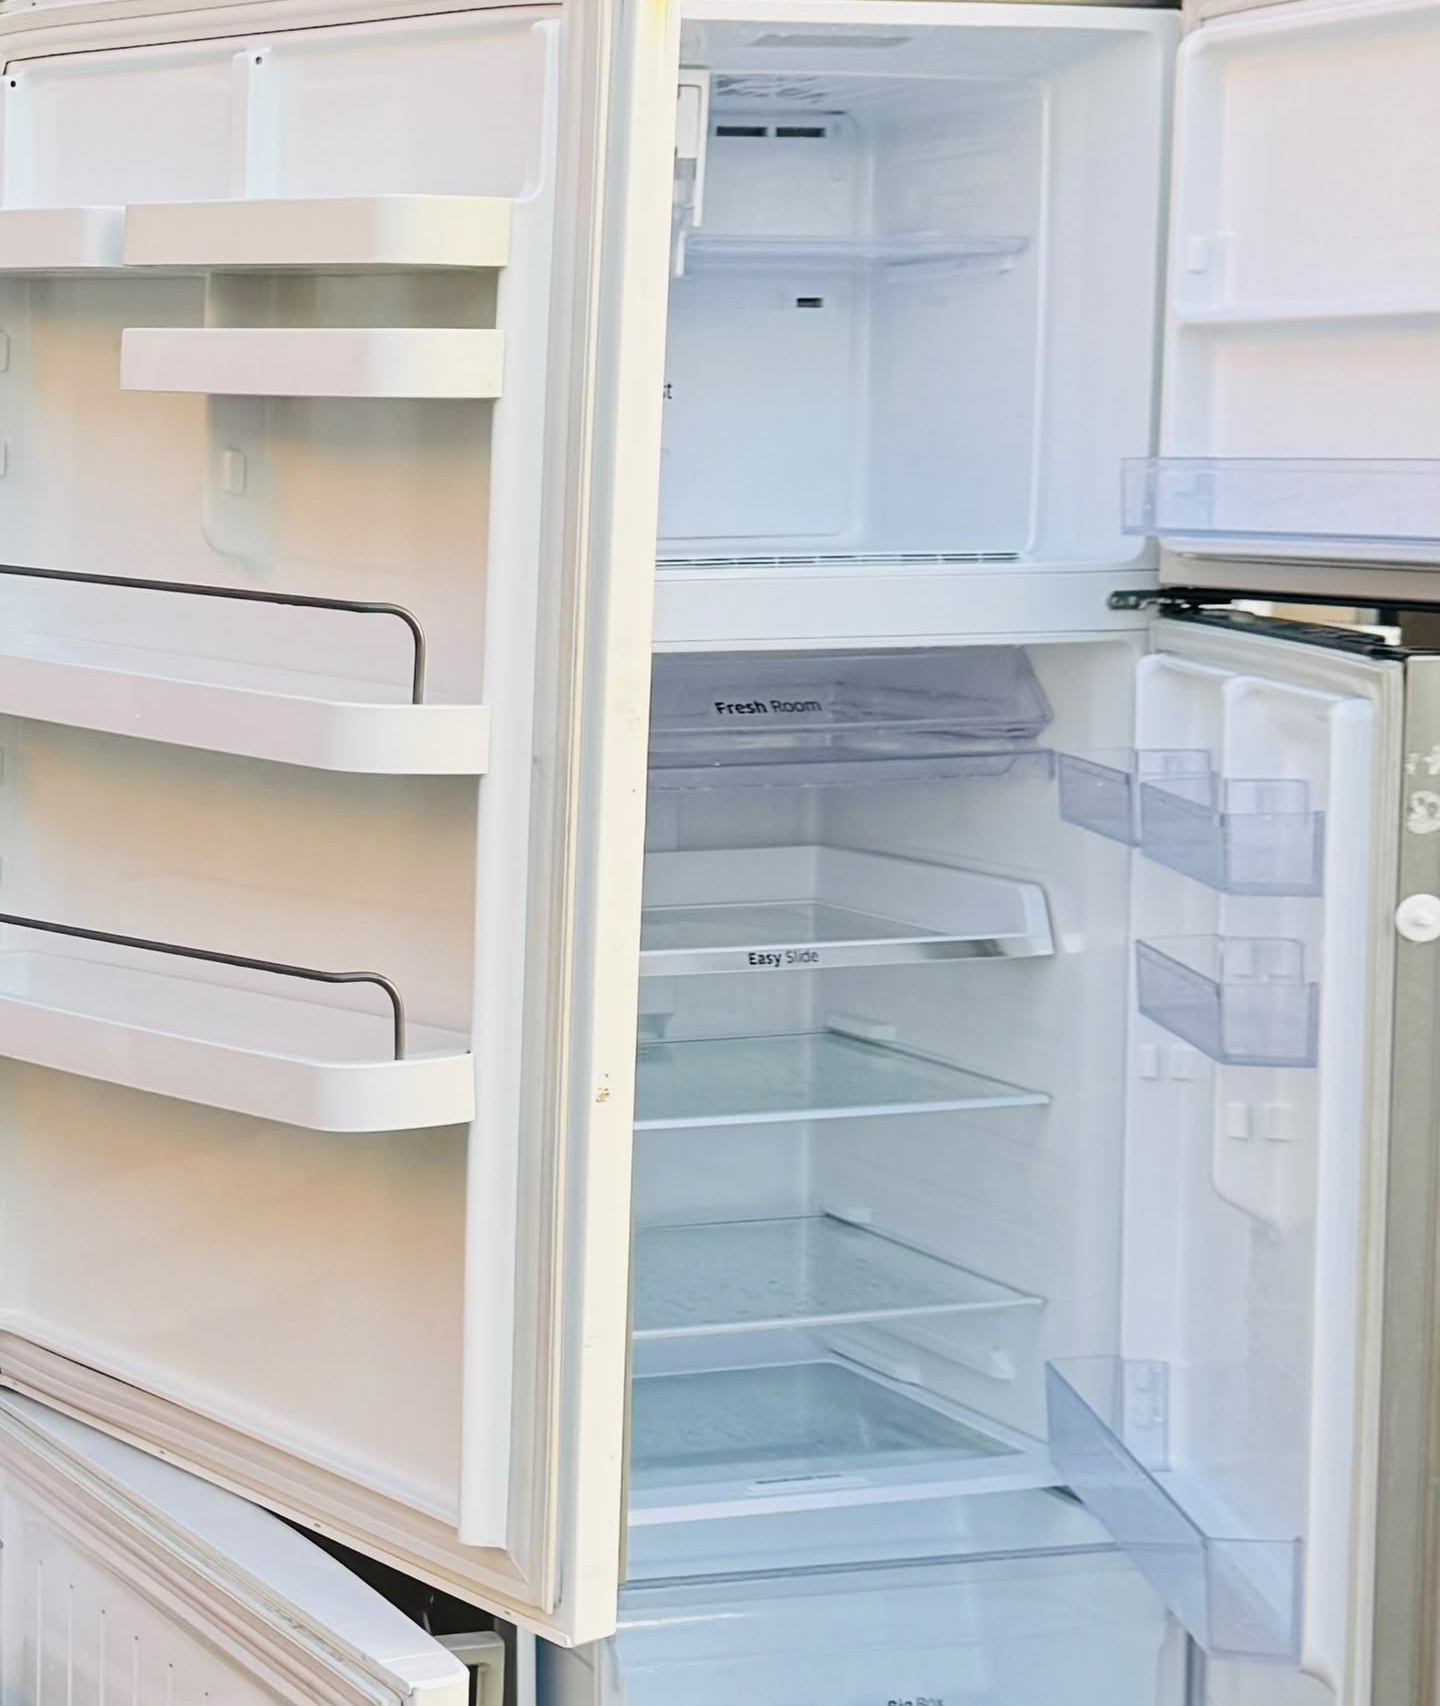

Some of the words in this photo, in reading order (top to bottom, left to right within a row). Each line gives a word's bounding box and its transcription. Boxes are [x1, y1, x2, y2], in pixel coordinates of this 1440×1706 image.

[715, 700, 768, 715] Fresh
[771, 699, 822, 714] Room
[748, 951, 782, 968] Easy
[785, 949, 819, 964] Slide
